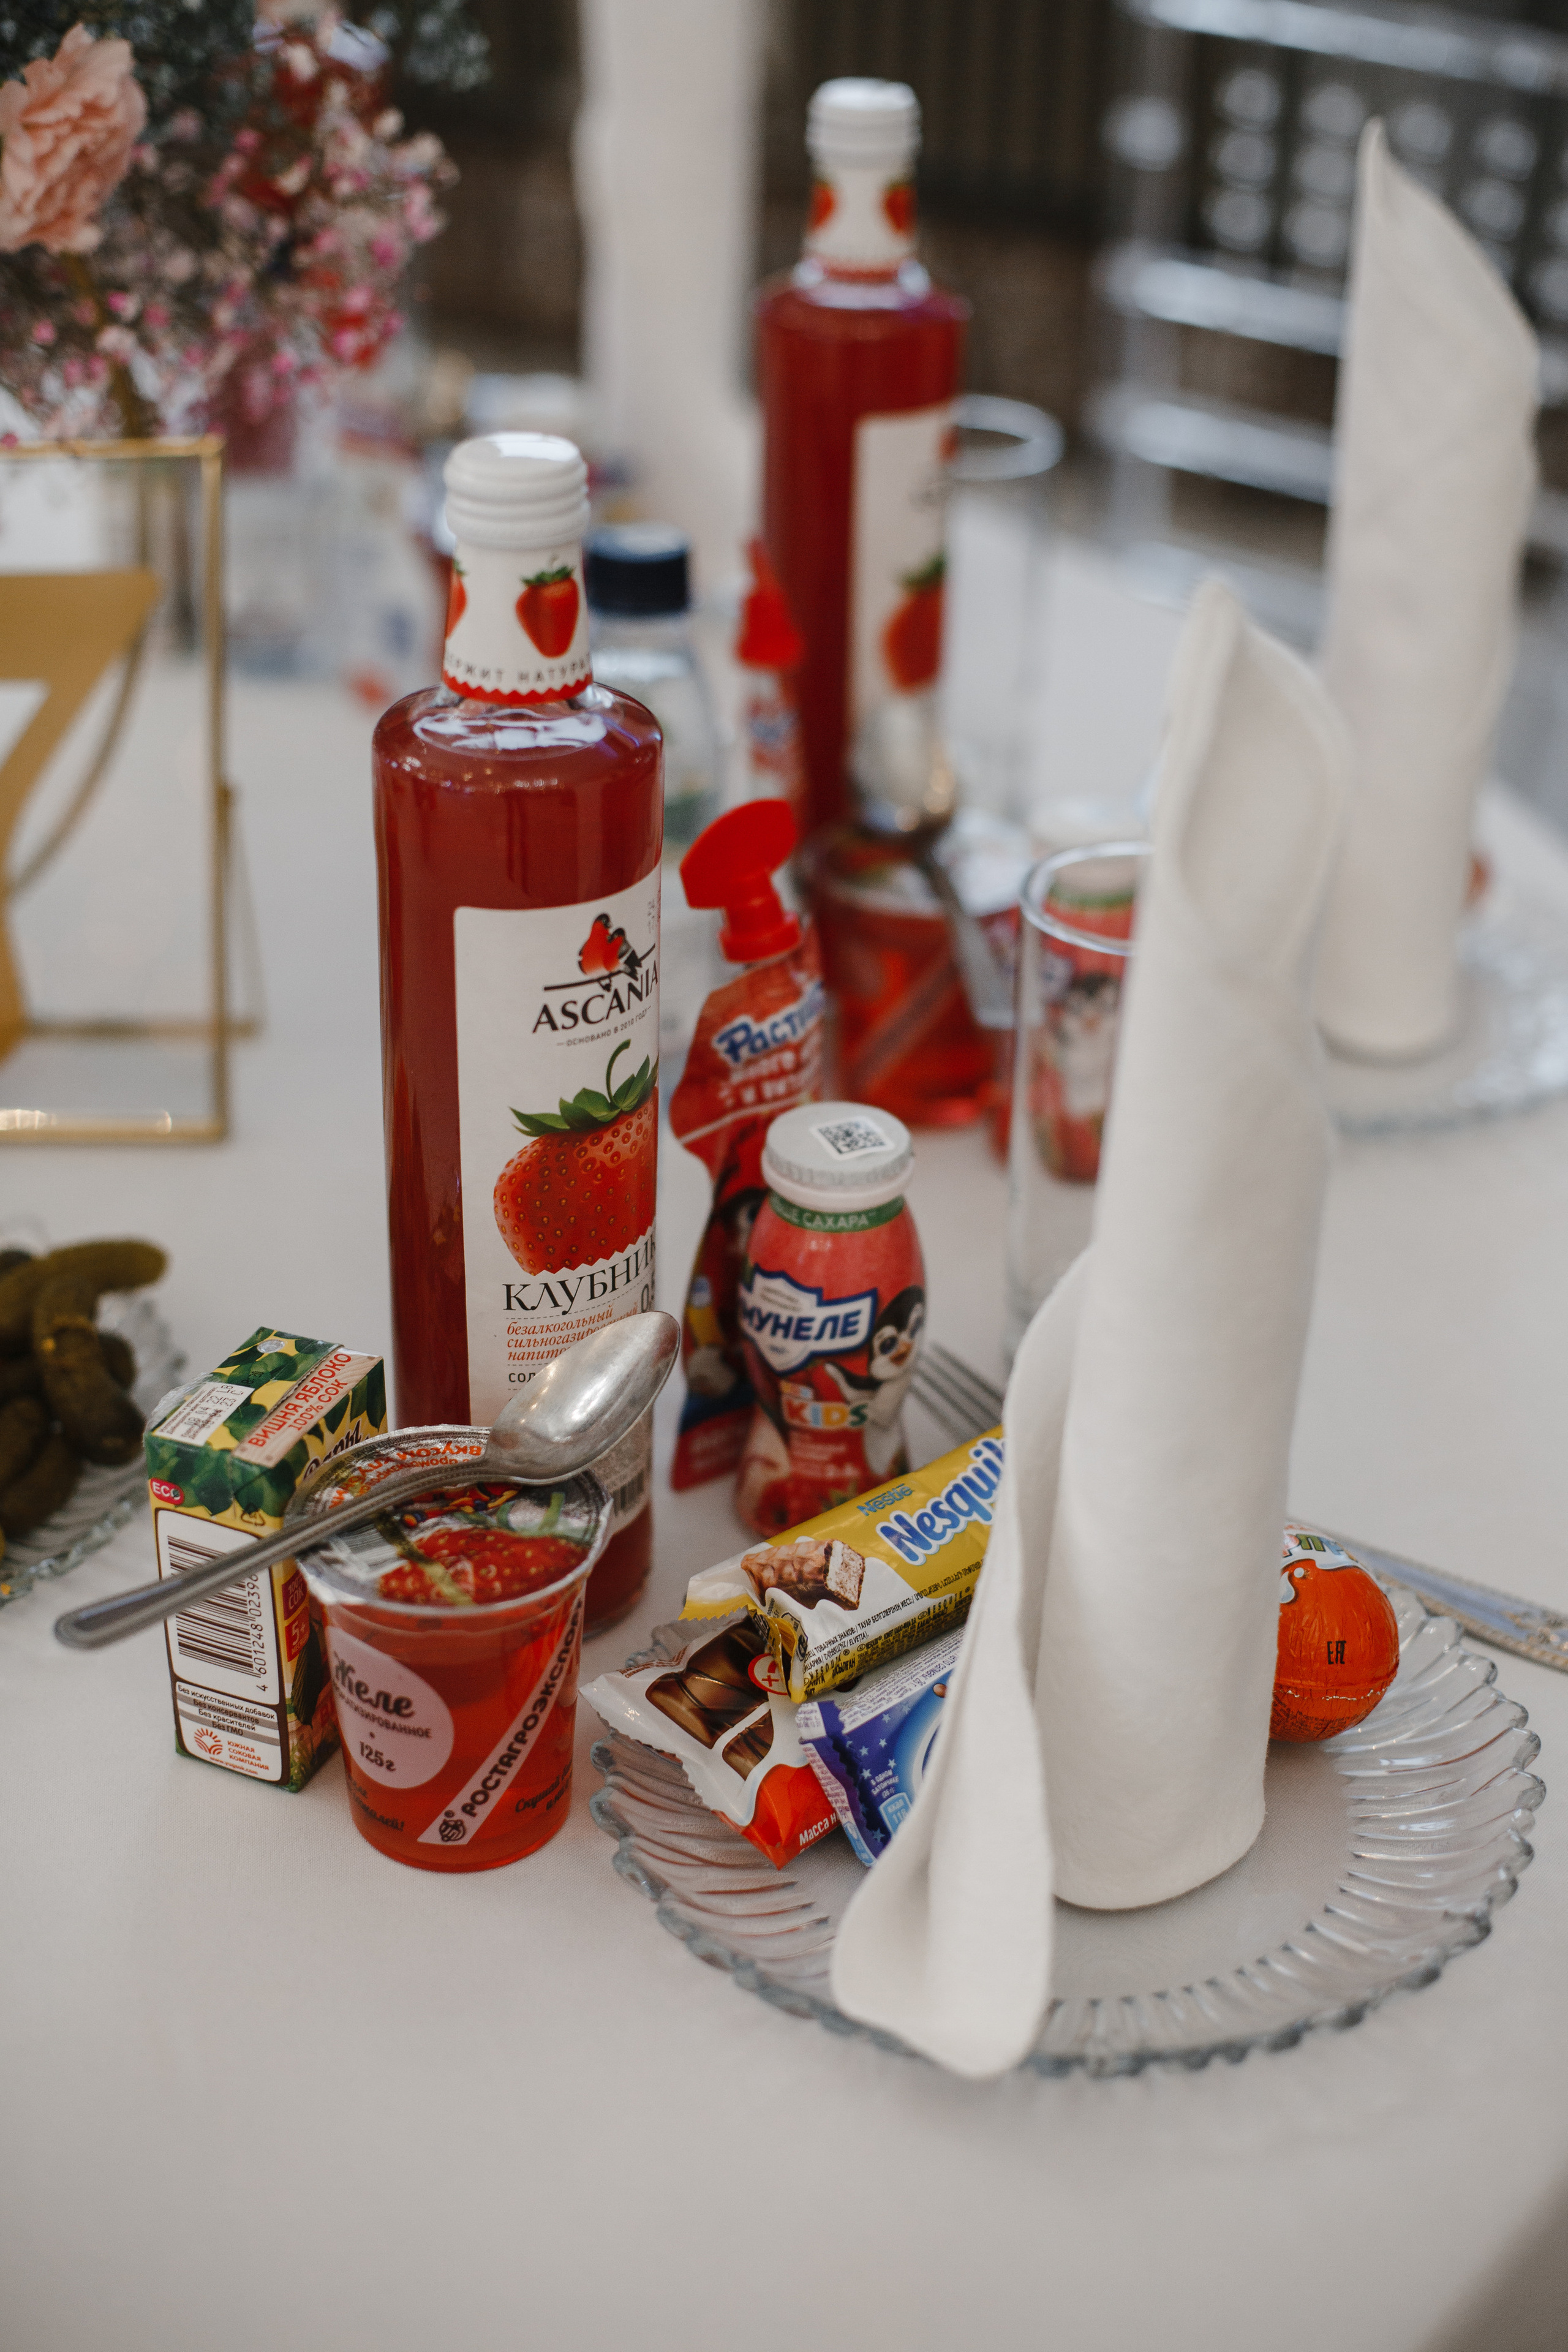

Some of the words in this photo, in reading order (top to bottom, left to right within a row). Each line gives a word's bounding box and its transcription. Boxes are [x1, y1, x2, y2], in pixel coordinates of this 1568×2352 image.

[532, 959, 658, 1033] ASCANIA
[567, 1028, 612, 1047] ОСНОВАНО
[620, 1020, 635, 1031] 2010
[507, 1303, 614, 1335] безалкогольный
[507, 1347, 571, 1361] напито
[247, 1403, 303, 1447] ВИШНЯ
[295, 1353, 352, 1403] ЯБЛОКО
[288, 1404, 323, 1431] 100%
[317, 1379, 348, 1403] СОК
[152, 1481, 182, 1501] ECO
[250, 1623, 267, 1675] 601248
[255, 1684, 268, 1692] 4
[178, 1684, 190, 1695] Без
[190, 1690, 244, 1711] искусственных
[244, 1706, 276, 1720] добавок
[193, 1698, 207, 1709] Без
[208, 1705, 260, 1724] консервантов
[198, 1708, 212, 1718] Без
[213, 1714, 256, 1732] красителей
[212, 1721, 225, 1731] Без
[226, 1725, 244, 1736] ГМО
[227, 1740, 255, 1753] ЮЖНАЯ
[228, 1747, 262, 1762] СОКОВАЯ
[229, 1754, 270, 1771] КОМПАНИЯ
[799, 1817, 830, 1847] Масса
